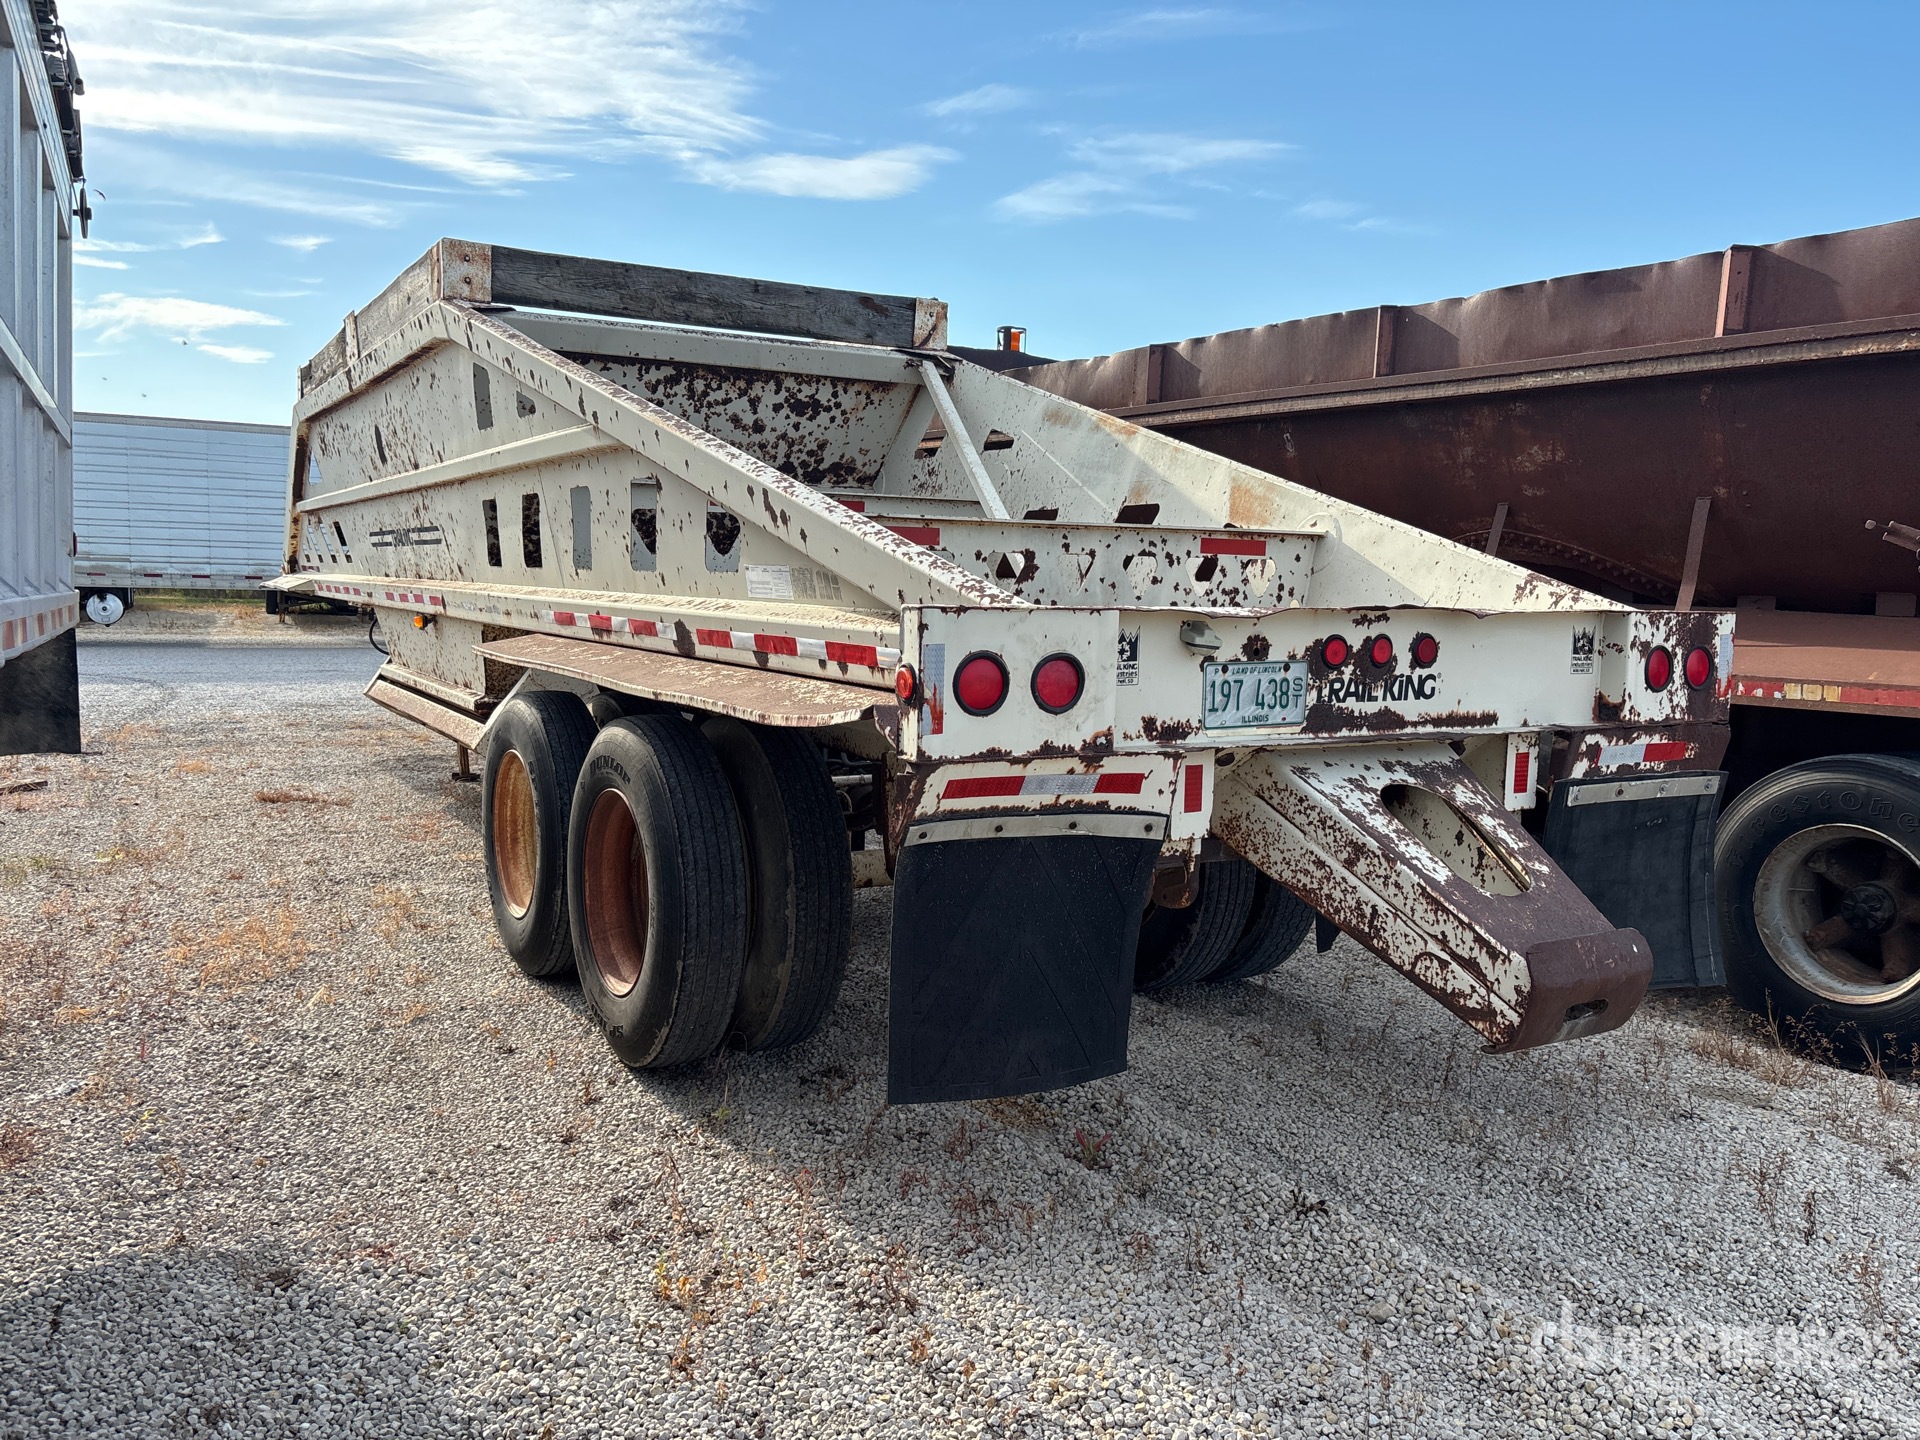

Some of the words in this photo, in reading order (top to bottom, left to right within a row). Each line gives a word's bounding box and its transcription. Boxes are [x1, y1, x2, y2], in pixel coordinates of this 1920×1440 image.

[1231, 666, 1249, 675] LAND
[1249, 666, 1258, 674] OF
[1257, 665, 1282, 674] LINCOLN
[1208, 679, 1244, 712] 197
[1254, 678, 1290, 710] 438
[1241, 714, 1270, 723] ILLINOIS
[590, 754, 631, 784] DUNLOP
